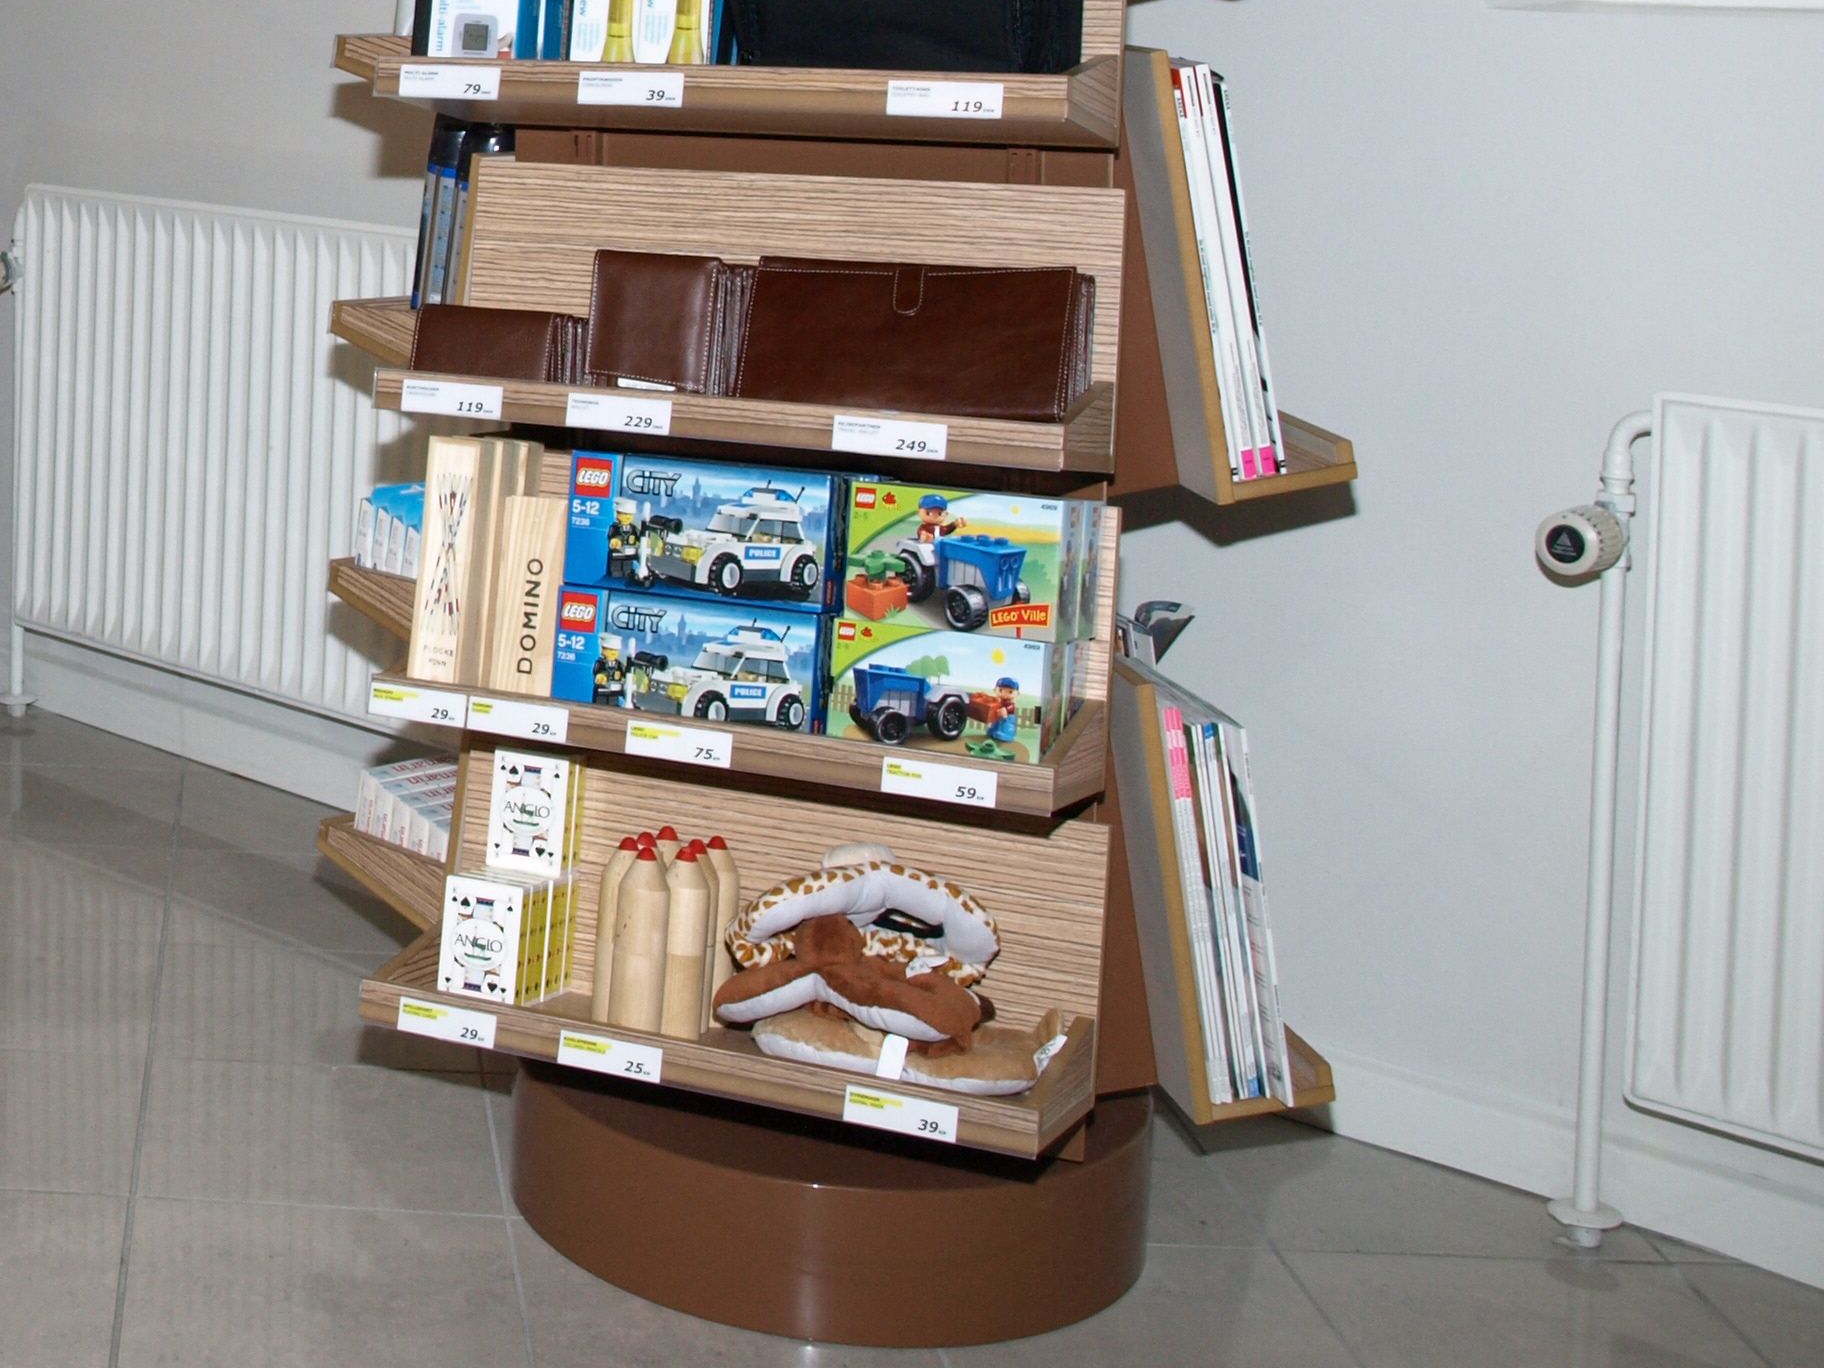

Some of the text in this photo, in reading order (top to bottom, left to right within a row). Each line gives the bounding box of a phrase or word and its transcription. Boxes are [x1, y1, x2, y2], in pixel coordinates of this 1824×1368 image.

[463, 83, 481, 95] 79
[645, 89, 666, 101] 39
[951, 100, 983, 113] 119
[456, 401, 484, 413] 119
[624, 415, 653, 429] 229
[895, 438, 927, 453] 249
[576, 469, 609, 486] LEGO
[625, 469, 682, 498] CITY
[572, 499, 600, 515] 5-12
[748, 547, 777, 558] POLICE
[516, 558, 544, 675] DOMINO
[563, 604, 594, 620] LEGO
[611, 604, 668, 634] CITY
[991, 609, 1047, 624] LEGO Ville
[558, 633, 585, 650] 5-12
[734, 686, 762, 697] POLICE
[430, 707, 449, 720] 29
[531, 722, 550, 735] 29
[694, 746, 714, 760] 75
[955, 785, 977, 799] 59
[503, 800, 551, 819] ANGLO
[454, 933, 503, 954] ANGLO
[460, 1027, 478, 1040] 29
[624, 1060, 645, 1074] 25
[917, 1118, 939, 1133] 39
